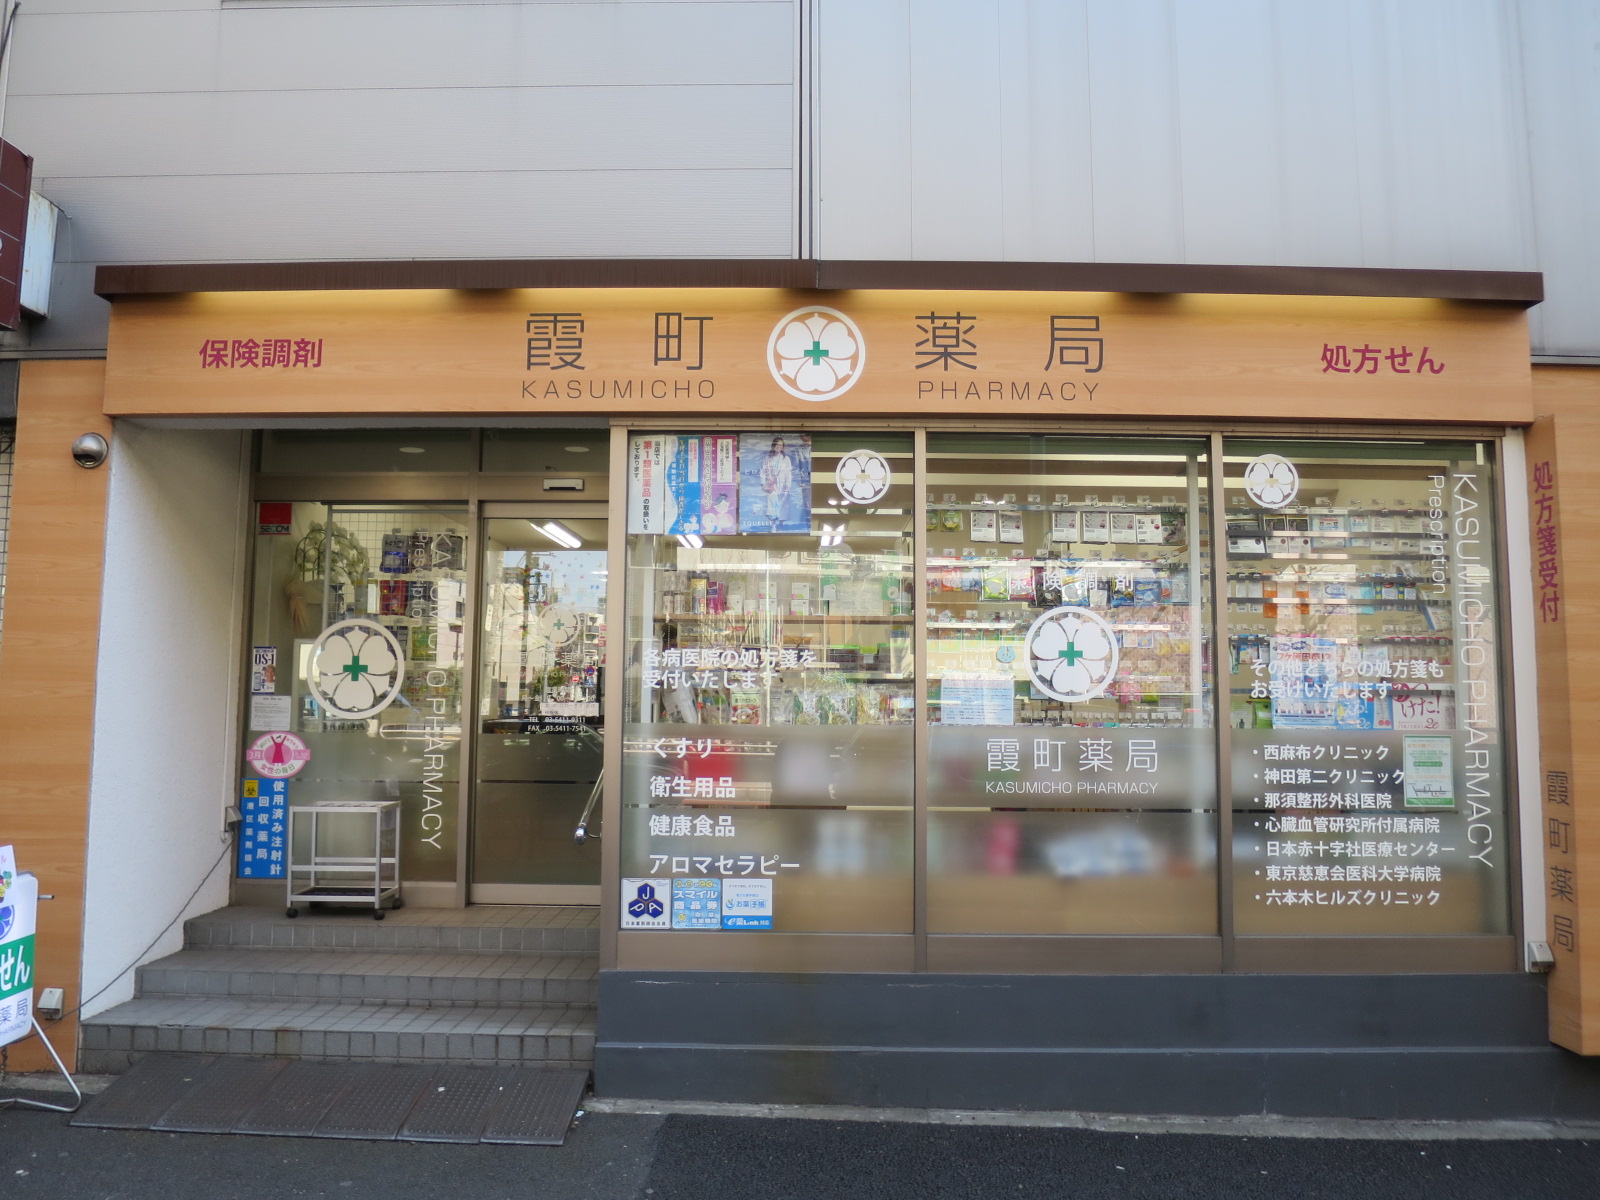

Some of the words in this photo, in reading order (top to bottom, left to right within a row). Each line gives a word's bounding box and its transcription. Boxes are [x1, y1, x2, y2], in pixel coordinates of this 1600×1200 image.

[199, 338, 323, 368] 保険調剤
[1320, 343, 1445, 375] 処方せん
[522, 379, 715, 399] KASUMICHO
[918, 381, 1100, 402] PHARMACY
[260, 525, 290, 533] SECOM
[1428, 475, 1448, 594] Prescription
[1533, 461, 1560, 624] 処方箋受付
[1453, 474, 1485, 666] KASUMICHO
[254, 654, 275, 665] OS-1
[642, 648, 817, 669] 各病医院の処方箋を
[642, 670, 777, 690] 受付いたします
[653, 737, 713, 758] くすり
[985, 738, 1159, 773] 霞町薬局
[1263, 744, 1389, 761] 西麻布クリニック
[421, 698, 446, 850] PHARMACY
[1263, 768, 1405, 785] 神田第二クリニック
[1462, 679, 1494, 868] PHARMACY
[650, 775, 736, 799] 衛生用品
[985, 781, 1072, 794] KASUMICHO
[1077, 781, 1158, 794] PHARMACY
[1264, 792, 1392, 809] 那須整形外科医院
[256, 796, 269, 860] 回収薬局
[270, 781, 285, 875] 使用済み注射針
[649, 814, 736, 837] 健康食品
[1264, 817, 1440, 834] 心臓血管研究所付属病院
[1266, 841, 1456, 857] 日本赤十字社医療センター
[649, 854, 800, 876] アロマセラピー
[1547, 771, 1575, 953] 霞町薬局
[1266, 865, 1442, 882] 東京慈恵会医科大学病院
[674, 890, 718, 899] スマイル
[1266, 889, 1441, 906] 六本木ヒルズクリニック
